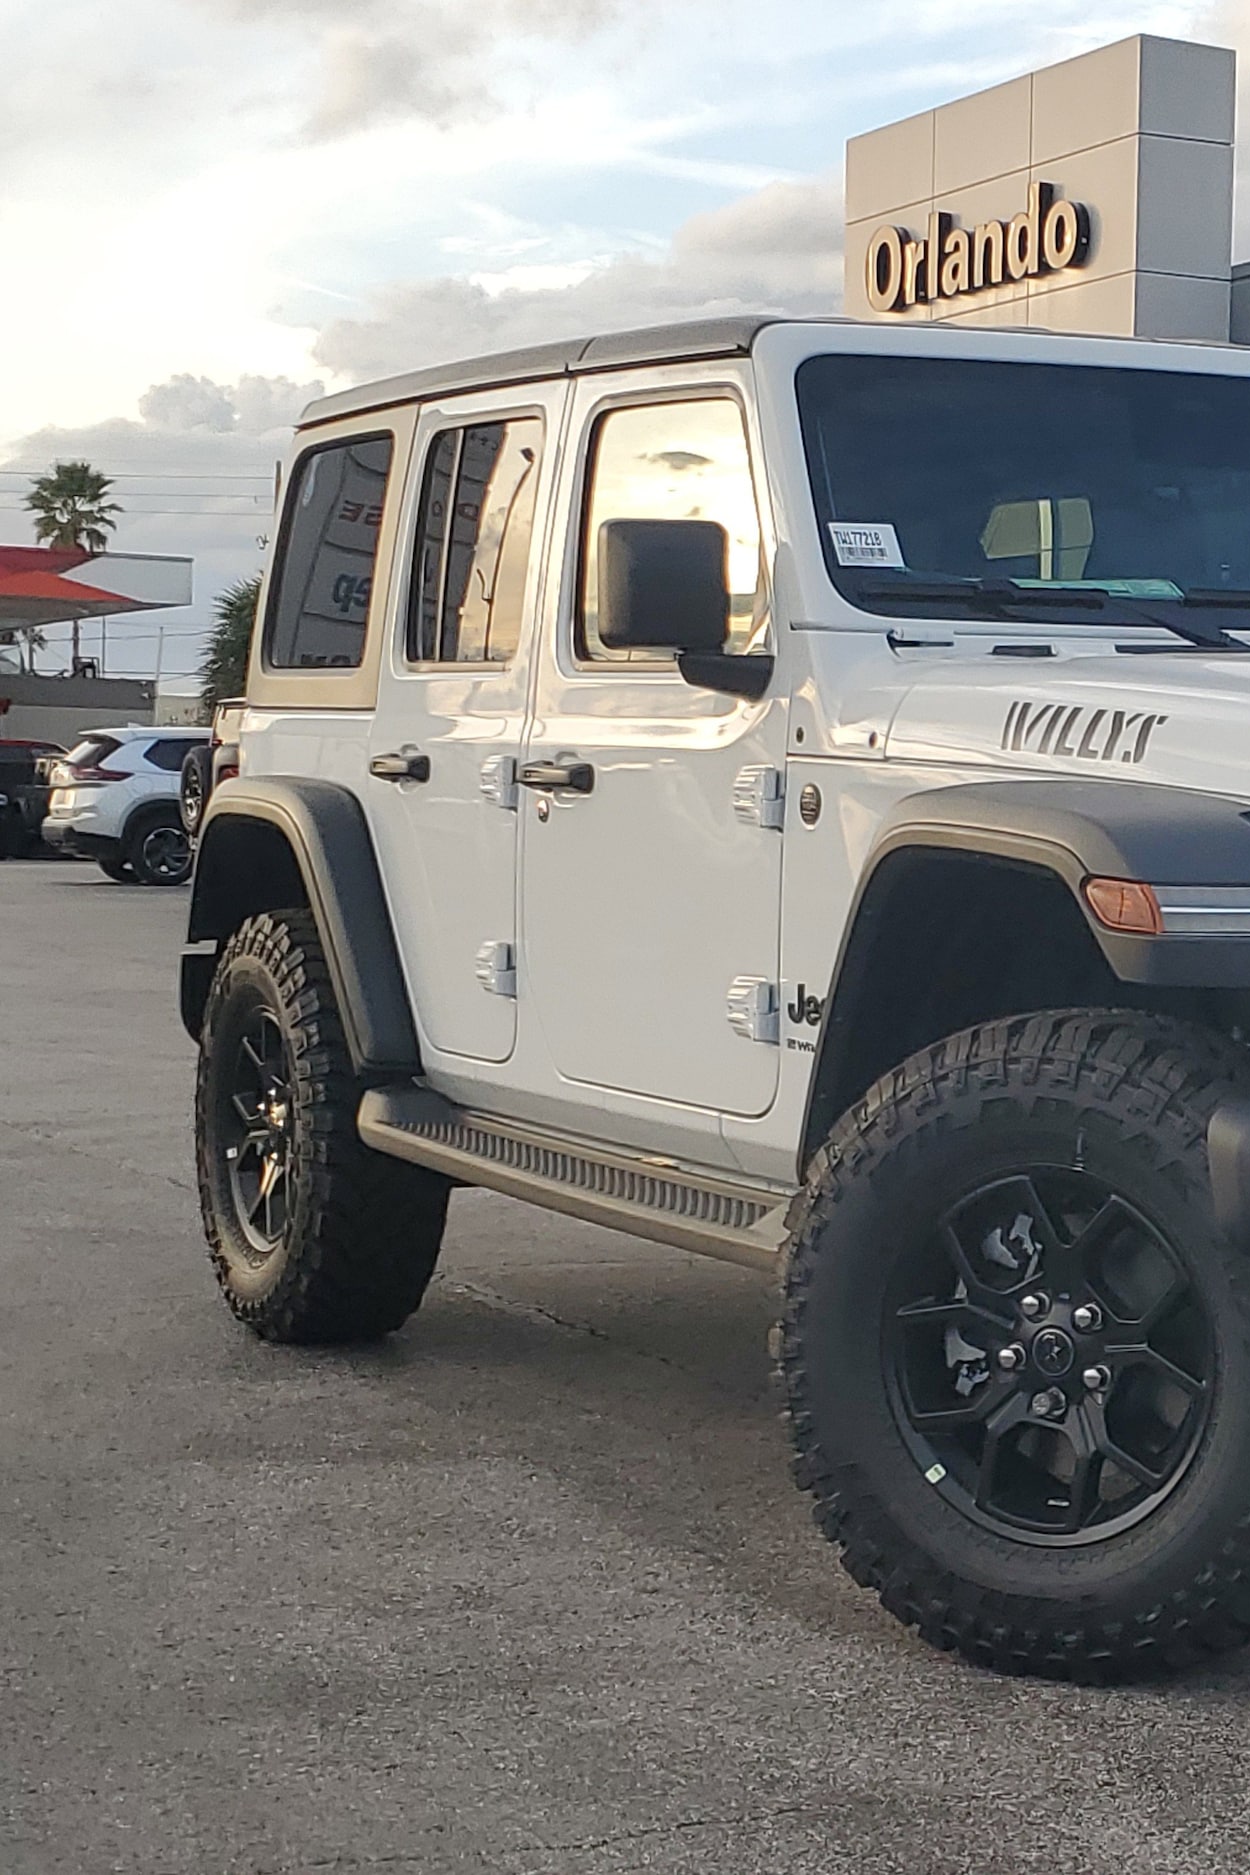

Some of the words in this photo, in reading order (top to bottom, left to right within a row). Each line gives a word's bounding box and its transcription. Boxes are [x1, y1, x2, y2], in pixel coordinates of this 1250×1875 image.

[866, 181, 1090, 313] Orlando
[1001, 701, 1169, 764] WILLYS
[788, 984, 828, 1026] Je
